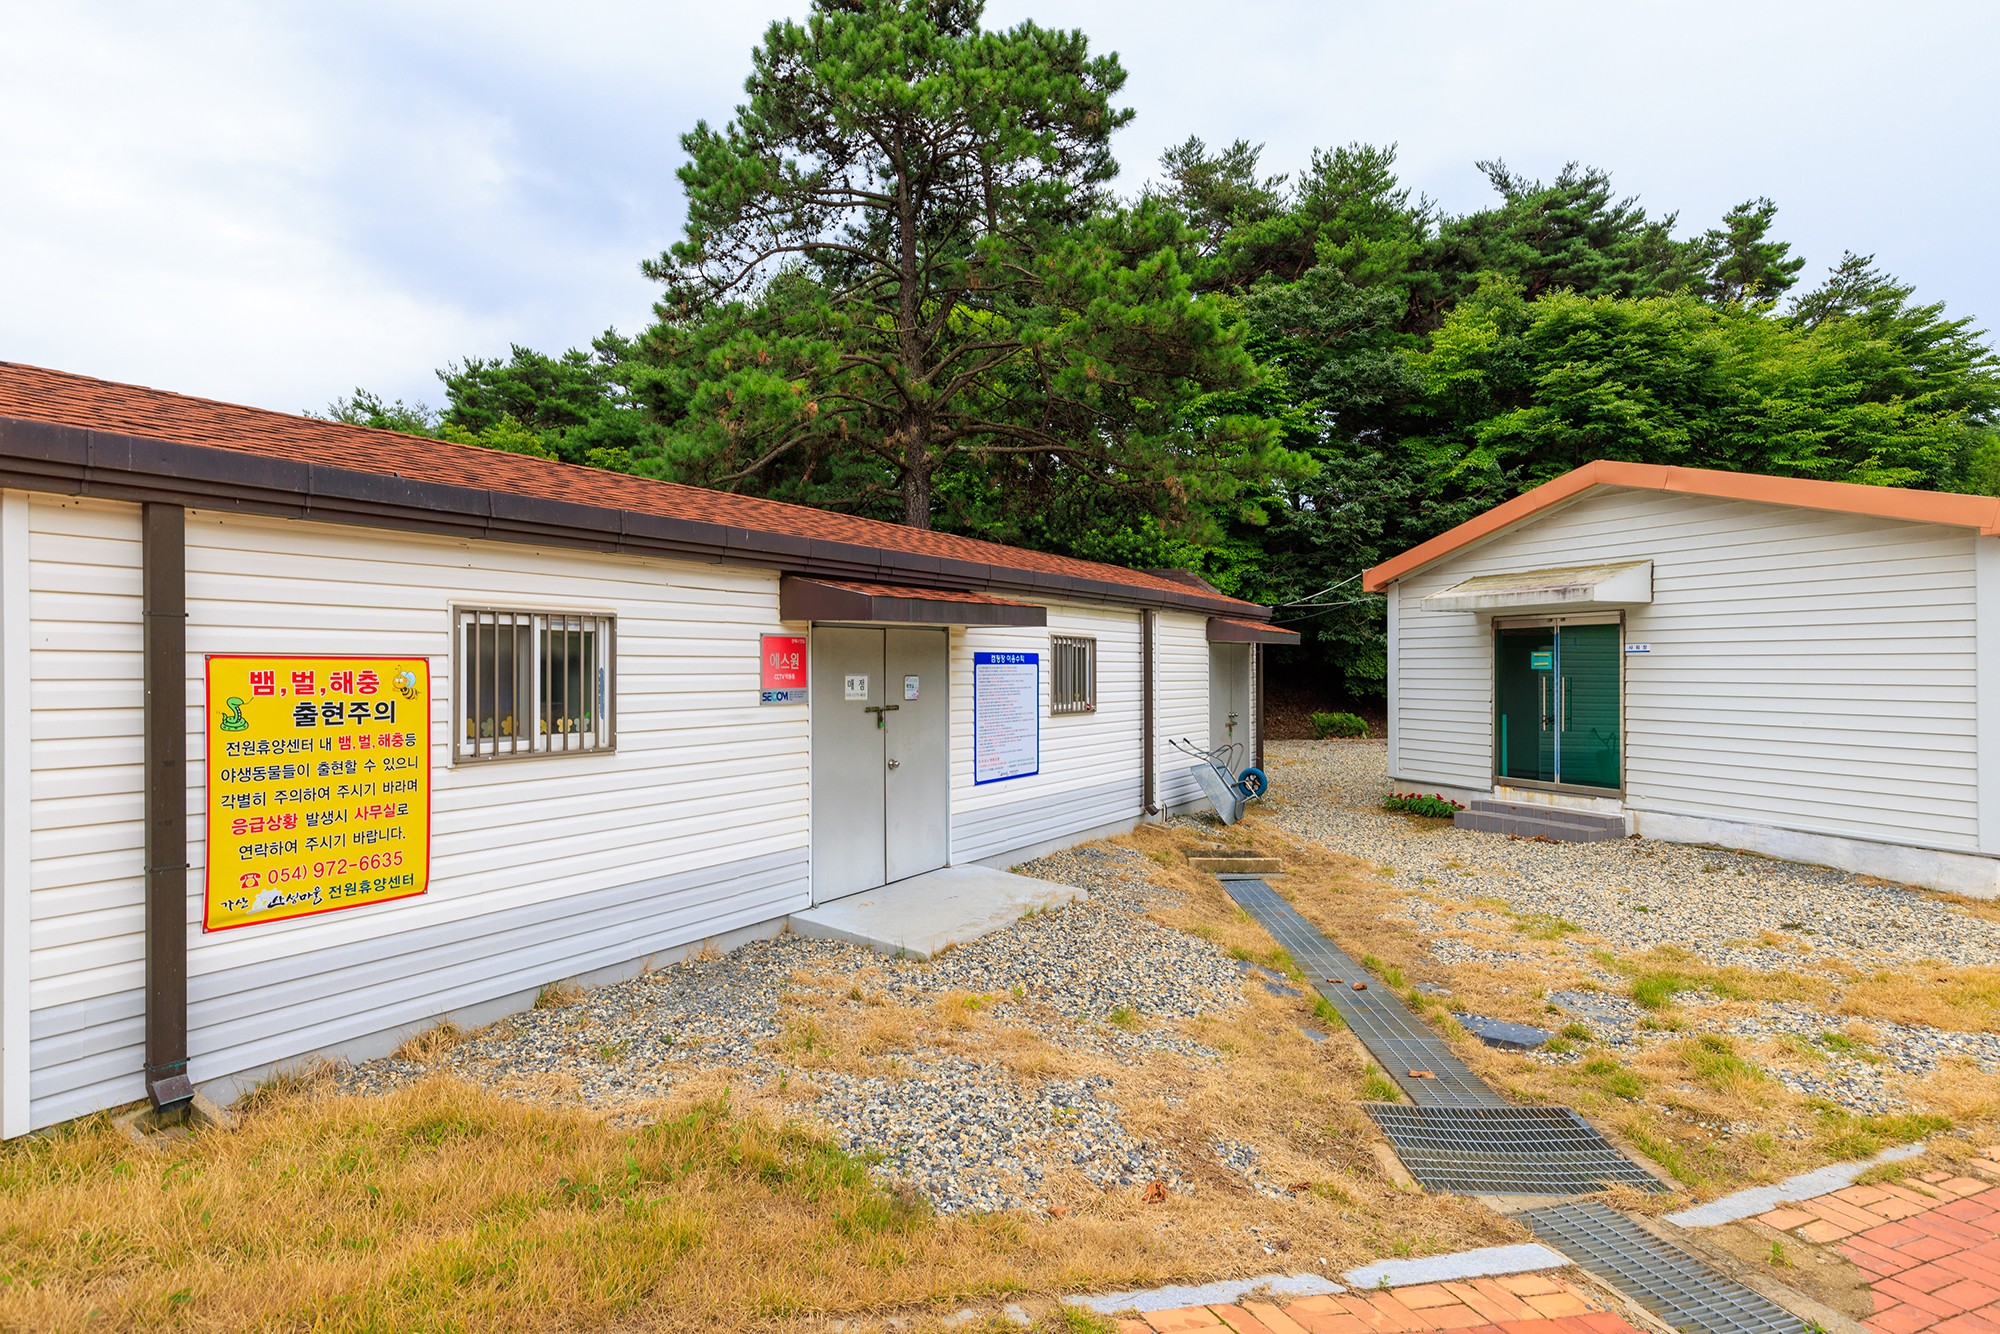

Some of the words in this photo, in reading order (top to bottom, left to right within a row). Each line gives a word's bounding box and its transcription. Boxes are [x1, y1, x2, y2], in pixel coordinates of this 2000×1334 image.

[770, 653, 799, 669] 에스원
[762, 691, 788, 701] SECOM
[292, 700, 396, 727] 출현주의
[226, 738, 314, 757] 전원휴양센터
[319, 737, 332, 752] 내
[221, 763, 311, 783] 야생동물들이
[317, 760, 358, 776] 출현할
[363, 759, 376, 770] 수
[383, 755, 418, 771] 있으니
[221, 792, 266, 809] 각별히
[274, 786, 331, 805] 주의하여
[336, 782, 377, 799] 주시기
[383, 778, 418, 795] 바라며
[231, 813, 299, 835] 응급상황
[306, 808, 348, 827] 발생시
[354, 803, 409, 821] 사무실로
[239, 839, 298, 861] 연락하여
[305, 833, 346, 852] 주시기
[353, 826, 406, 845] 바랍니다.
[268, 865, 308, 884] 054)
[313, 851, 403, 879] 972-6635
[329, 873, 414, 899] 전원휴양센터
